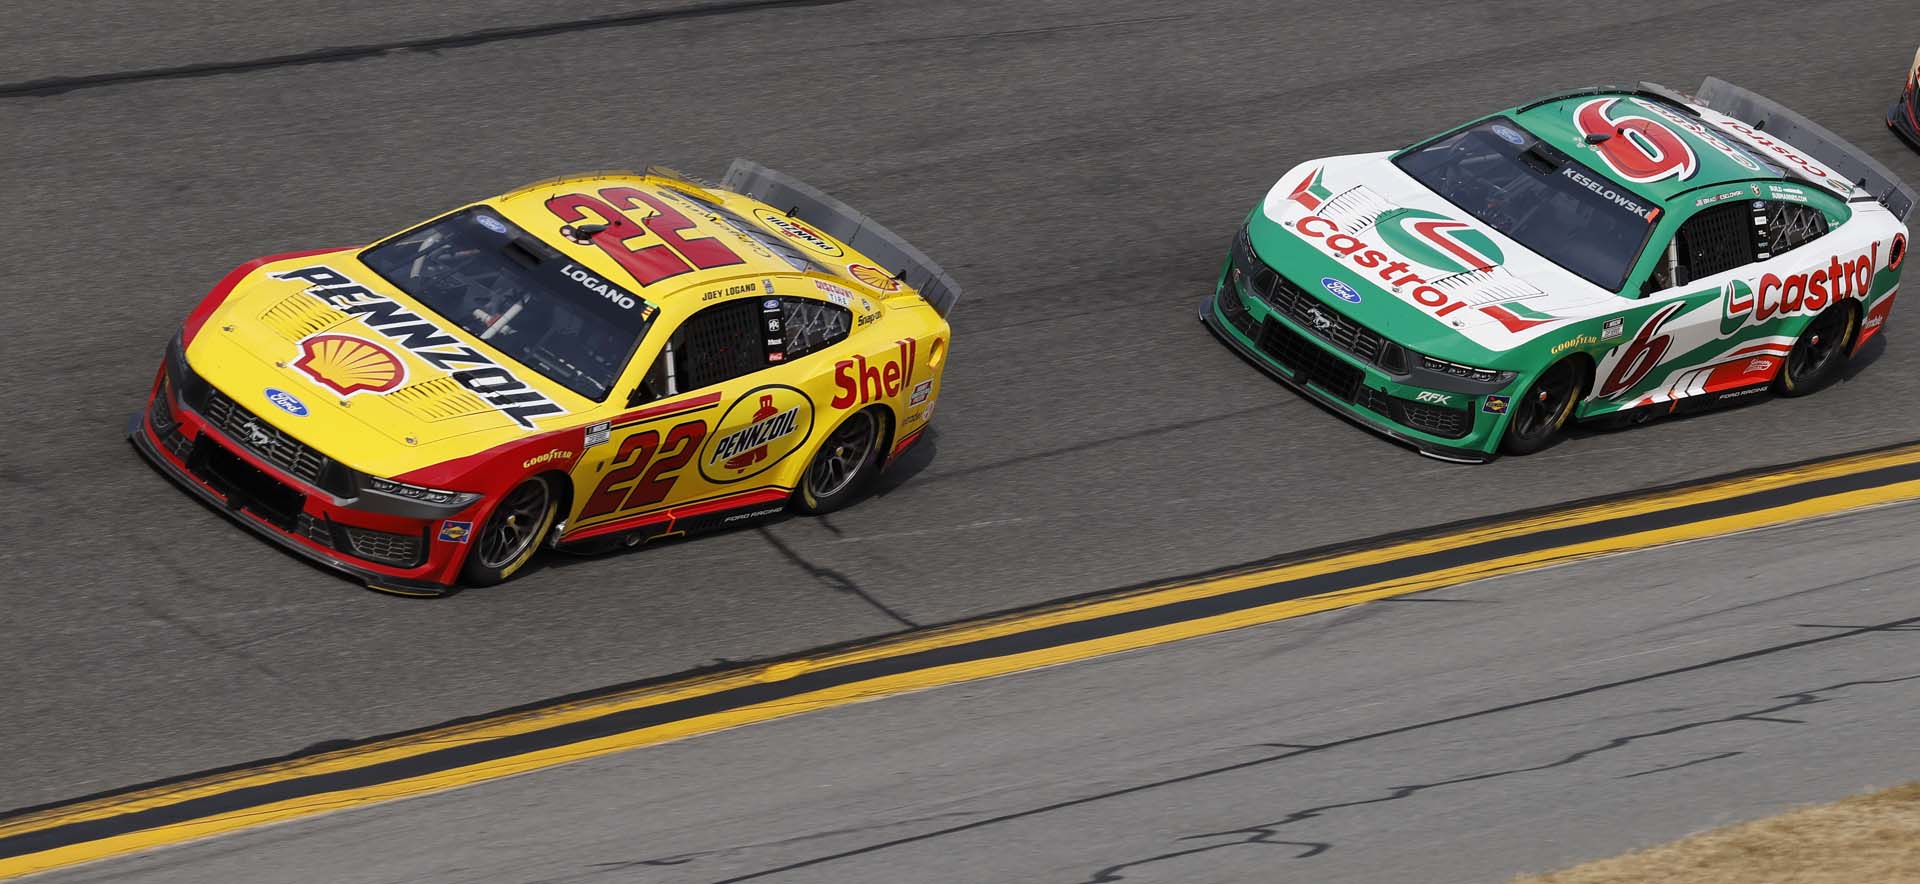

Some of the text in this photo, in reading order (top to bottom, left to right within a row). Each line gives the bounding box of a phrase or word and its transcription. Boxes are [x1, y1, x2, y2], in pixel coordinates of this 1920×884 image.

[1573, 98, 1698, 183] 6
[545, 186, 746, 287] 22
[766, 214, 834, 251] PENNZOIL
[560, 264, 636, 310] LOGANO
[702, 286, 723, 301] JOEY
[726, 283, 756, 297] LOGANO
[1295, 215, 1468, 319] Castrol
[1324, 280, 1358, 302] Ford
[1755, 240, 1877, 322] Castrol
[272, 265, 565, 430] PENNZOIL
[831, 337, 917, 410] Shell
[1551, 334, 1598, 354] GOODYEAR
[1600, 301, 1687, 398] 6
[271, 391, 303, 413] Ford
[1719, 386, 1768, 400] FORD RACING
[523, 449, 573, 469] GOODYEAR
[710, 406, 799, 465] PENNZOIL
[580, 420, 708, 521] 22
